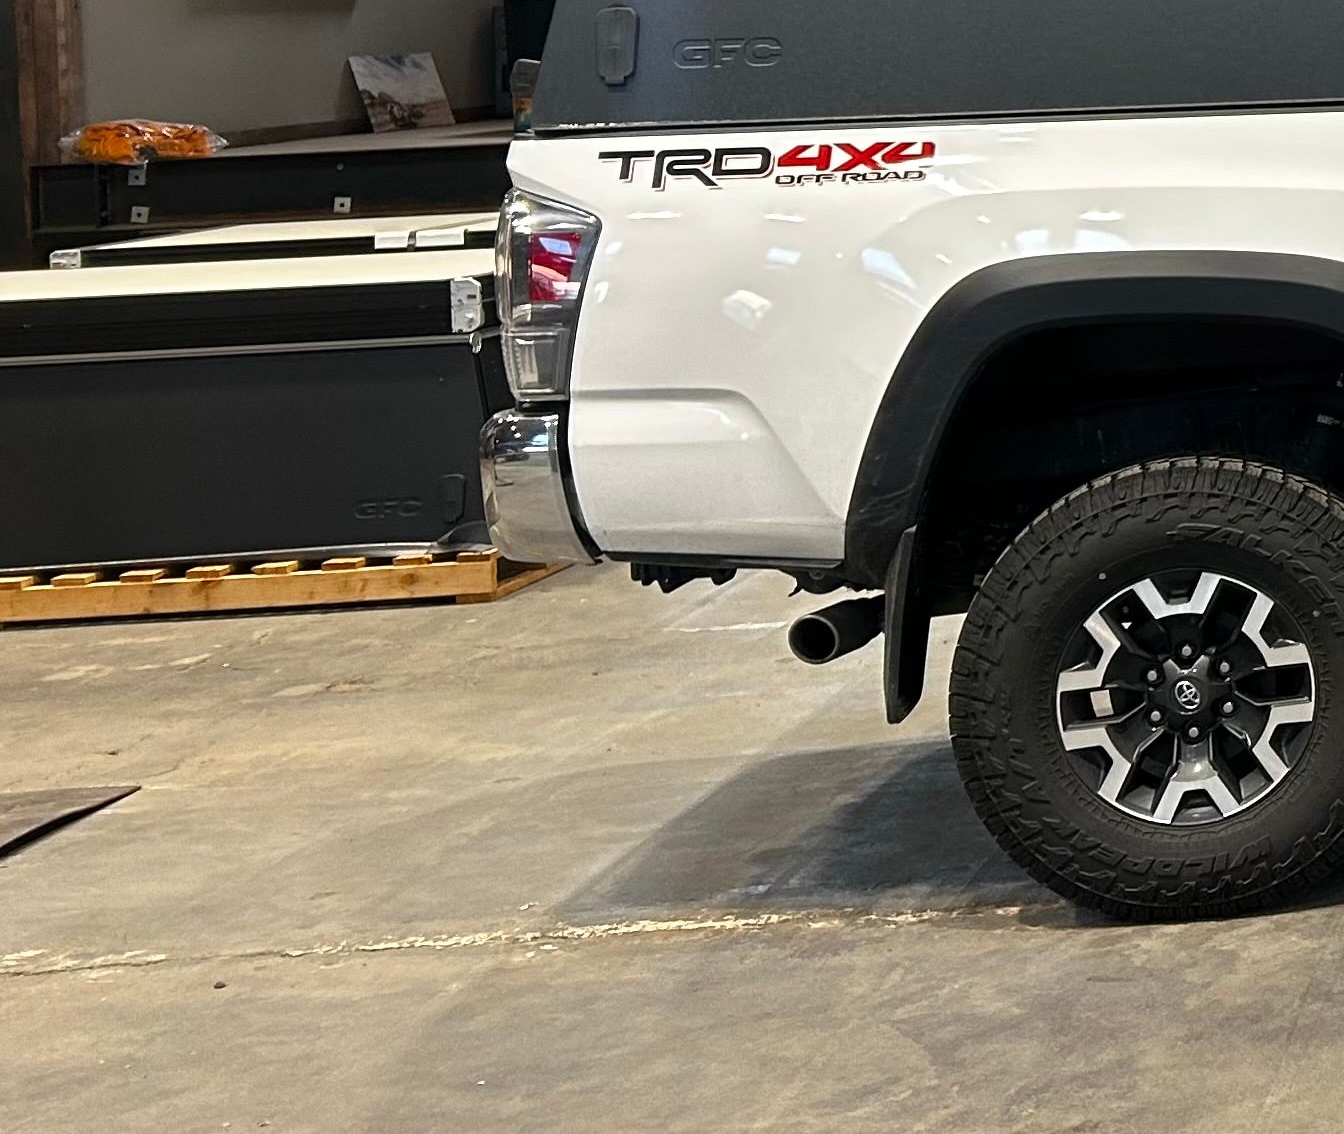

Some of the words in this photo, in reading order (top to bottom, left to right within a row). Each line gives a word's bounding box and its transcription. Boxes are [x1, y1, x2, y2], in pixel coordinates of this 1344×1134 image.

[672, 35, 783, 70] GFC
[598, 146, 775, 191] TRD
[774, 173, 836, 186] OFF
[841, 169, 926, 184] ROAD
[353, 496, 425, 521] GFC
[1041, 816, 1273, 878] WILDPEAK
